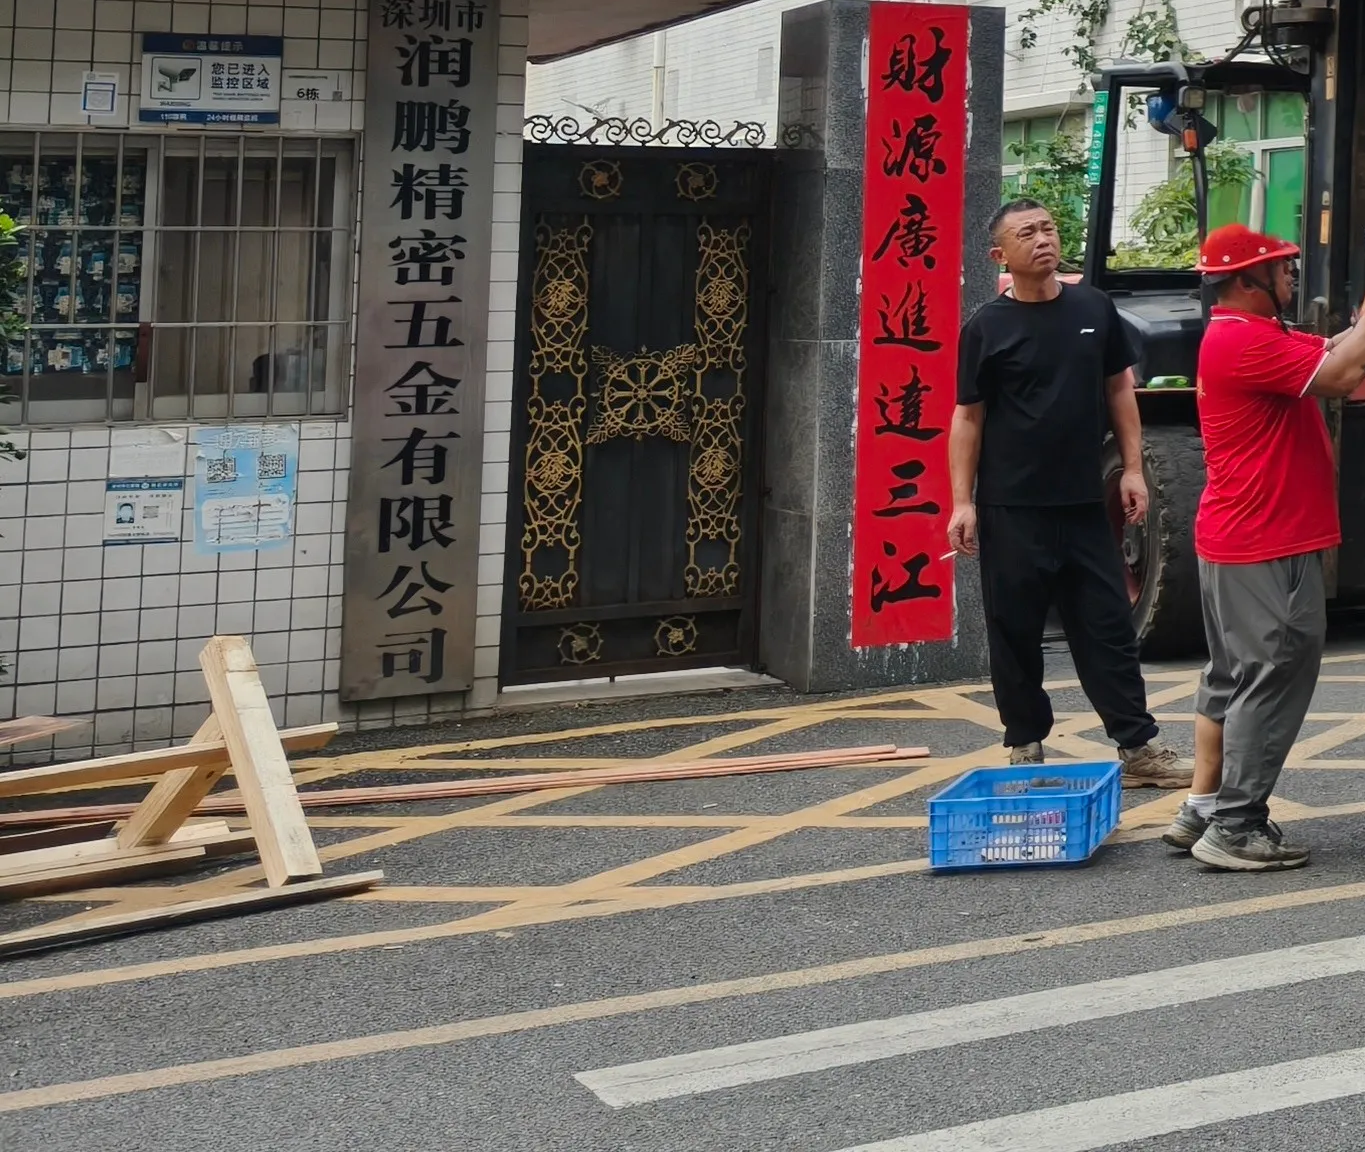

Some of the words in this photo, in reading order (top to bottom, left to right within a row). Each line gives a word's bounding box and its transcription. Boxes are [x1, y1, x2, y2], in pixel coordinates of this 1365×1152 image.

[211, 62, 270, 76] 您已进入
[211, 77, 270, 90] 监控区域
[375, 34, 474, 684] 润鹏精密五金有限公司
